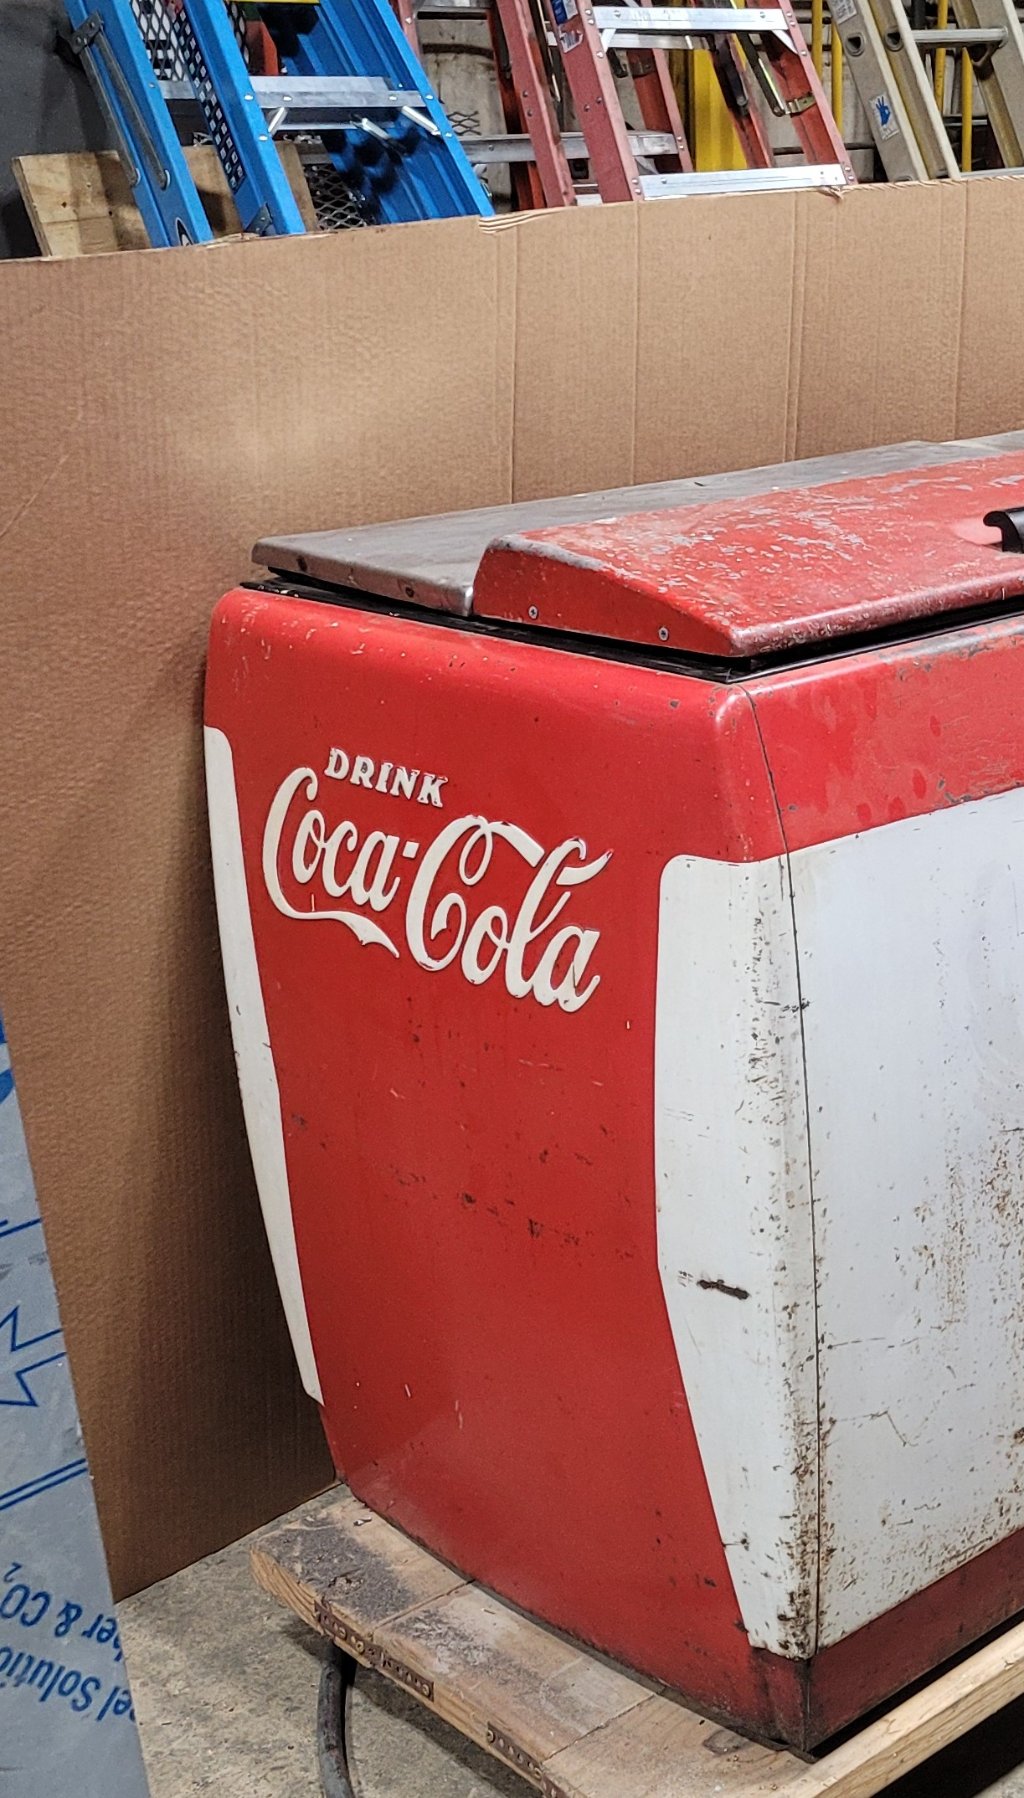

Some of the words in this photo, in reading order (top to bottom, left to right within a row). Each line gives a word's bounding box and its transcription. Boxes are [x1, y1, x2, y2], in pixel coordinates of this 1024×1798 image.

[324, 747, 449, 808] DRINK
[262, 767, 614, 1013] Coca-Cola
[54, 1602, 83, 1638] &
[97, 1685, 136, 1722] el
